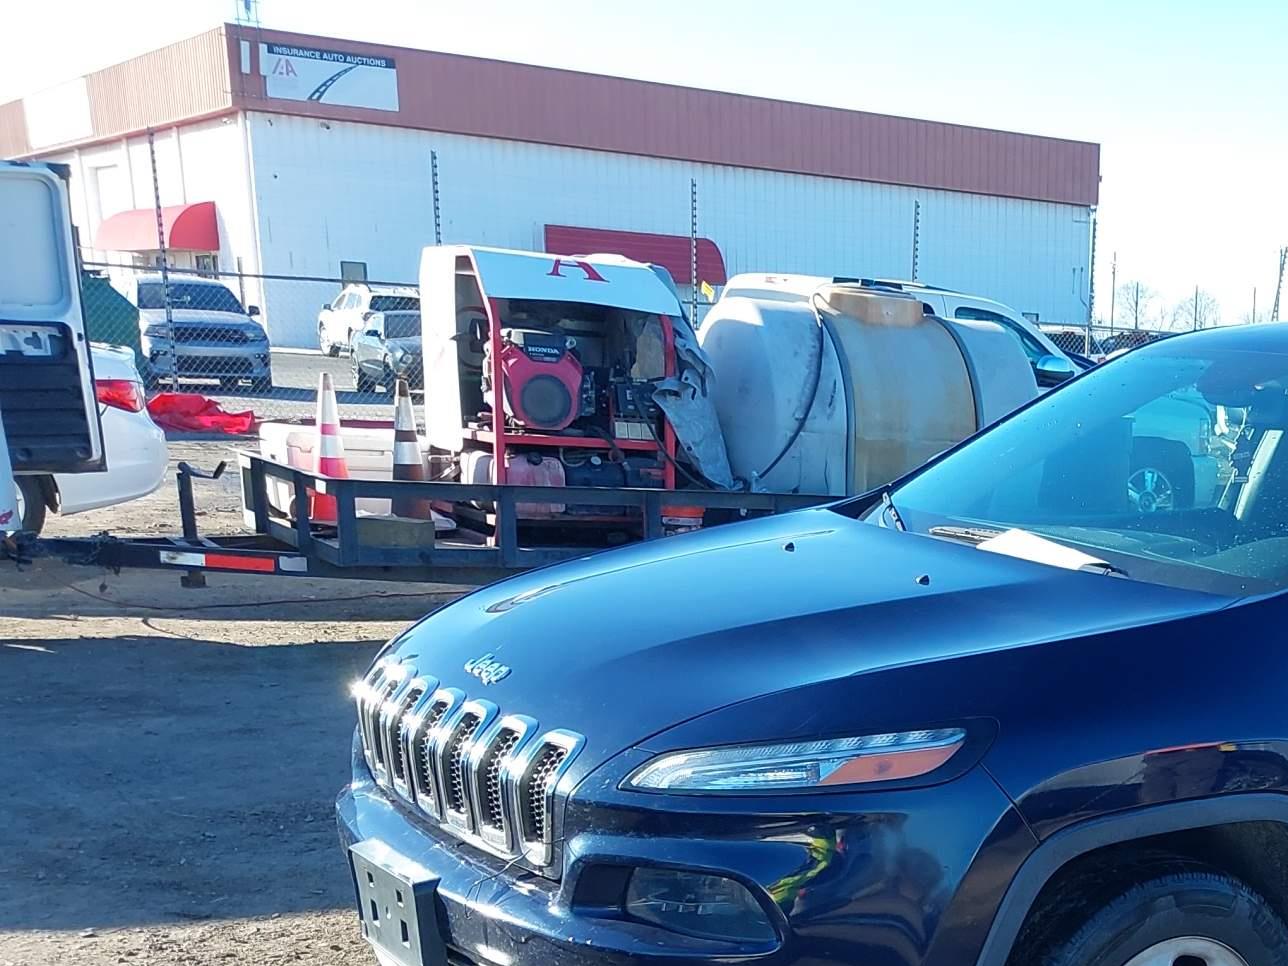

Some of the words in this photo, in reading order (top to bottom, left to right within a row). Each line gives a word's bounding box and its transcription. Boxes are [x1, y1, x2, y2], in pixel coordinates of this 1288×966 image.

[273, 46, 320, 59] INSURANCE
[322, 53, 345, 62] AUTO
[346, 56, 386, 67] AUCTIONS
[527, 346, 560, 354] HONDA
[464, 653, 512, 686] Jeep
